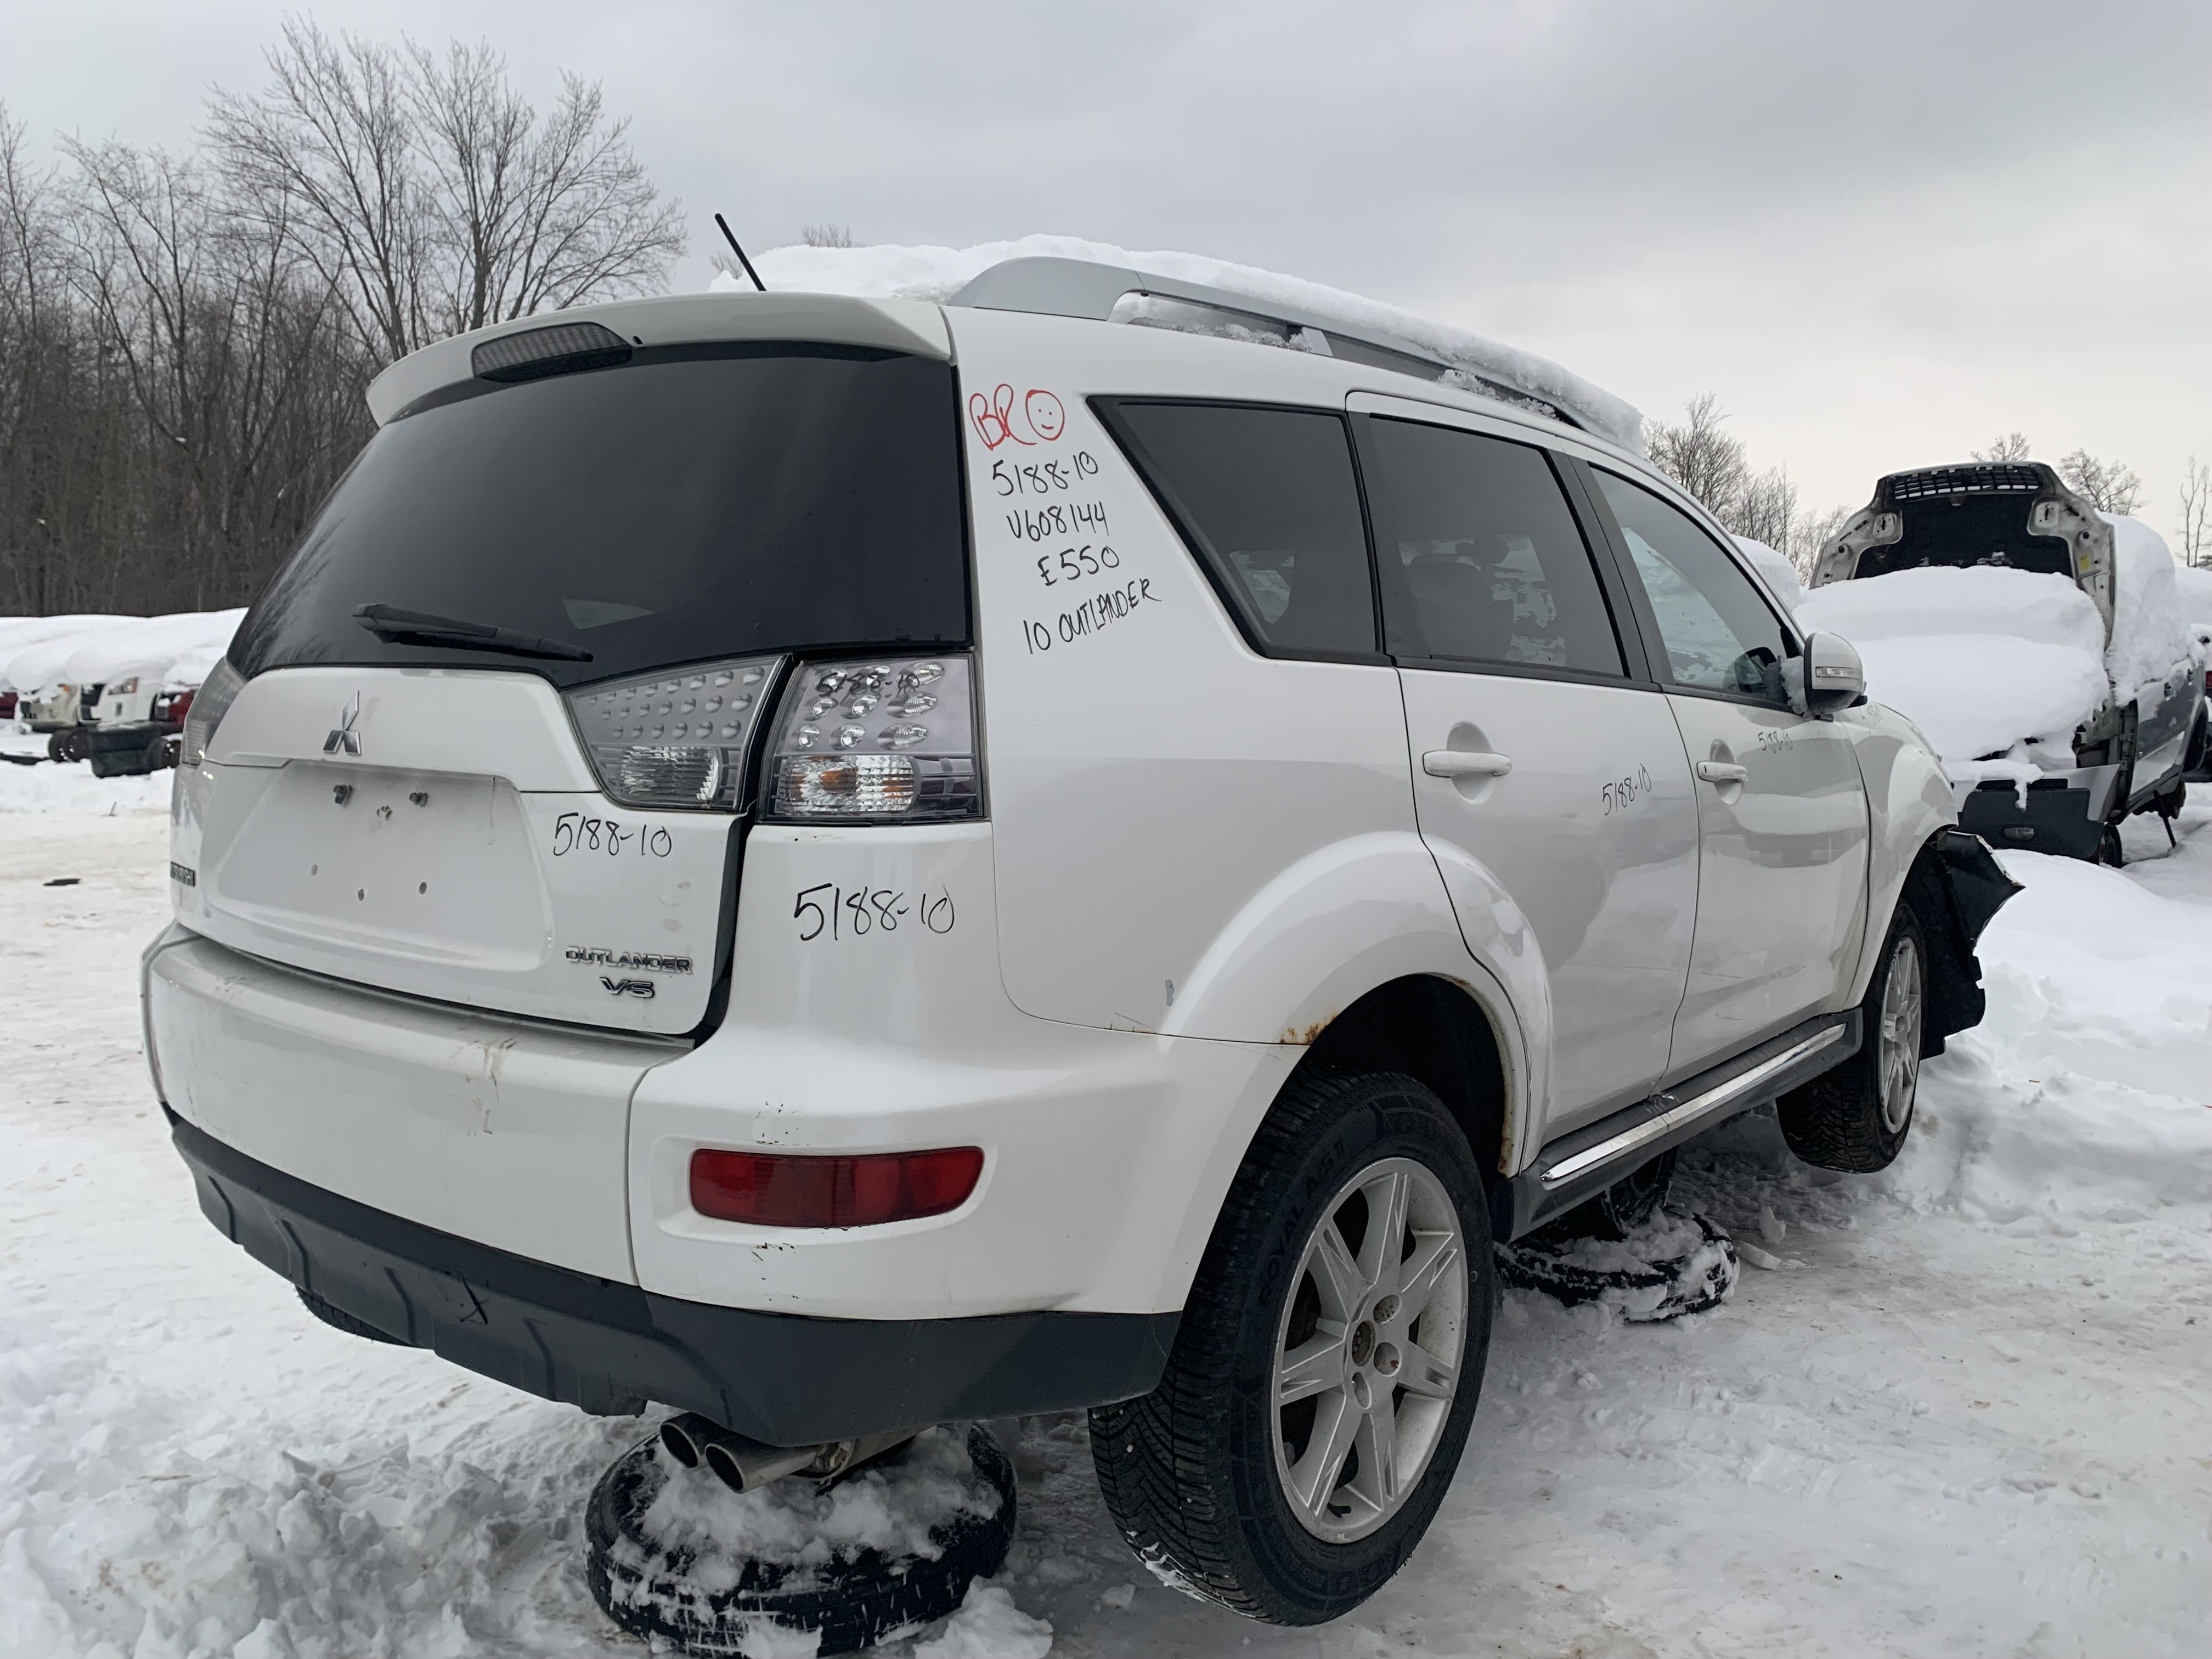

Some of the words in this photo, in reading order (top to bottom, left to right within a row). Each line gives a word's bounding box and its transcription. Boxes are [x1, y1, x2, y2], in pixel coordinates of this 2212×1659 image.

[991, 451, 1099, 496] 5188-10
[1037, 545, 1120, 586] E550
[1023, 619, 1051, 655] 10
[1058, 578, 1163, 642] OUTLANDER
[552, 812, 673, 857] 5188-10
[793, 882, 955, 941] 5188-10
[565, 945, 694, 975] OUTLANDER
[599, 977, 656, 998] V6
